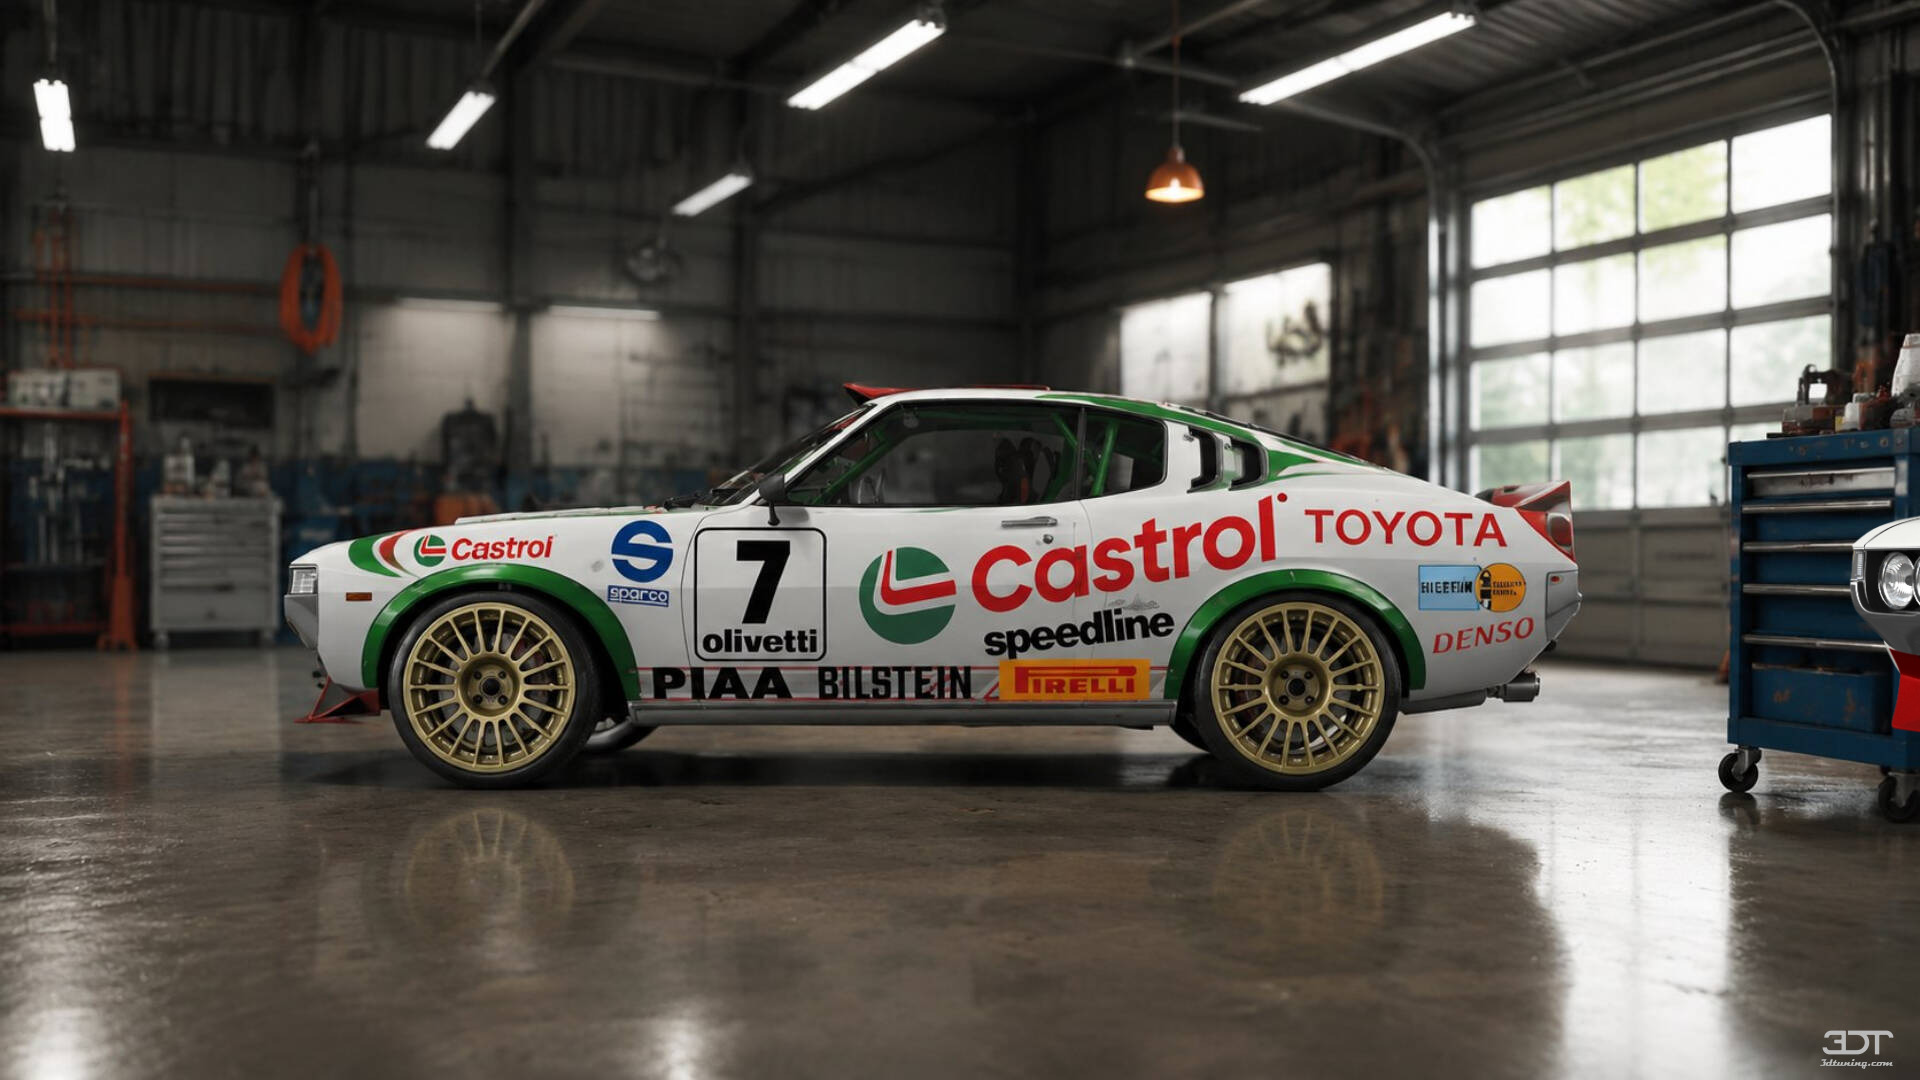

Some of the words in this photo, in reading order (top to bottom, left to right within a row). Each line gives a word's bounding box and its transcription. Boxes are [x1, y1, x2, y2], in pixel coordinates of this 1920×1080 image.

[1304, 509, 1508, 547] TOYOTA
[451, 536, 553, 560] Castrol
[971, 494, 1277, 613] Castrol
[610, 587, 668, 602] sparco
[736, 540, 791, 624] 7
[702, 629, 818, 653] olivetti
[983, 608, 1175, 660] speedline
[1432, 617, 1535, 654] DENSO
[652, 666, 793, 700] PIAA
[817, 666, 972, 700] BILSTEIN
[1014, 665, 1138, 694] PIRELLI
